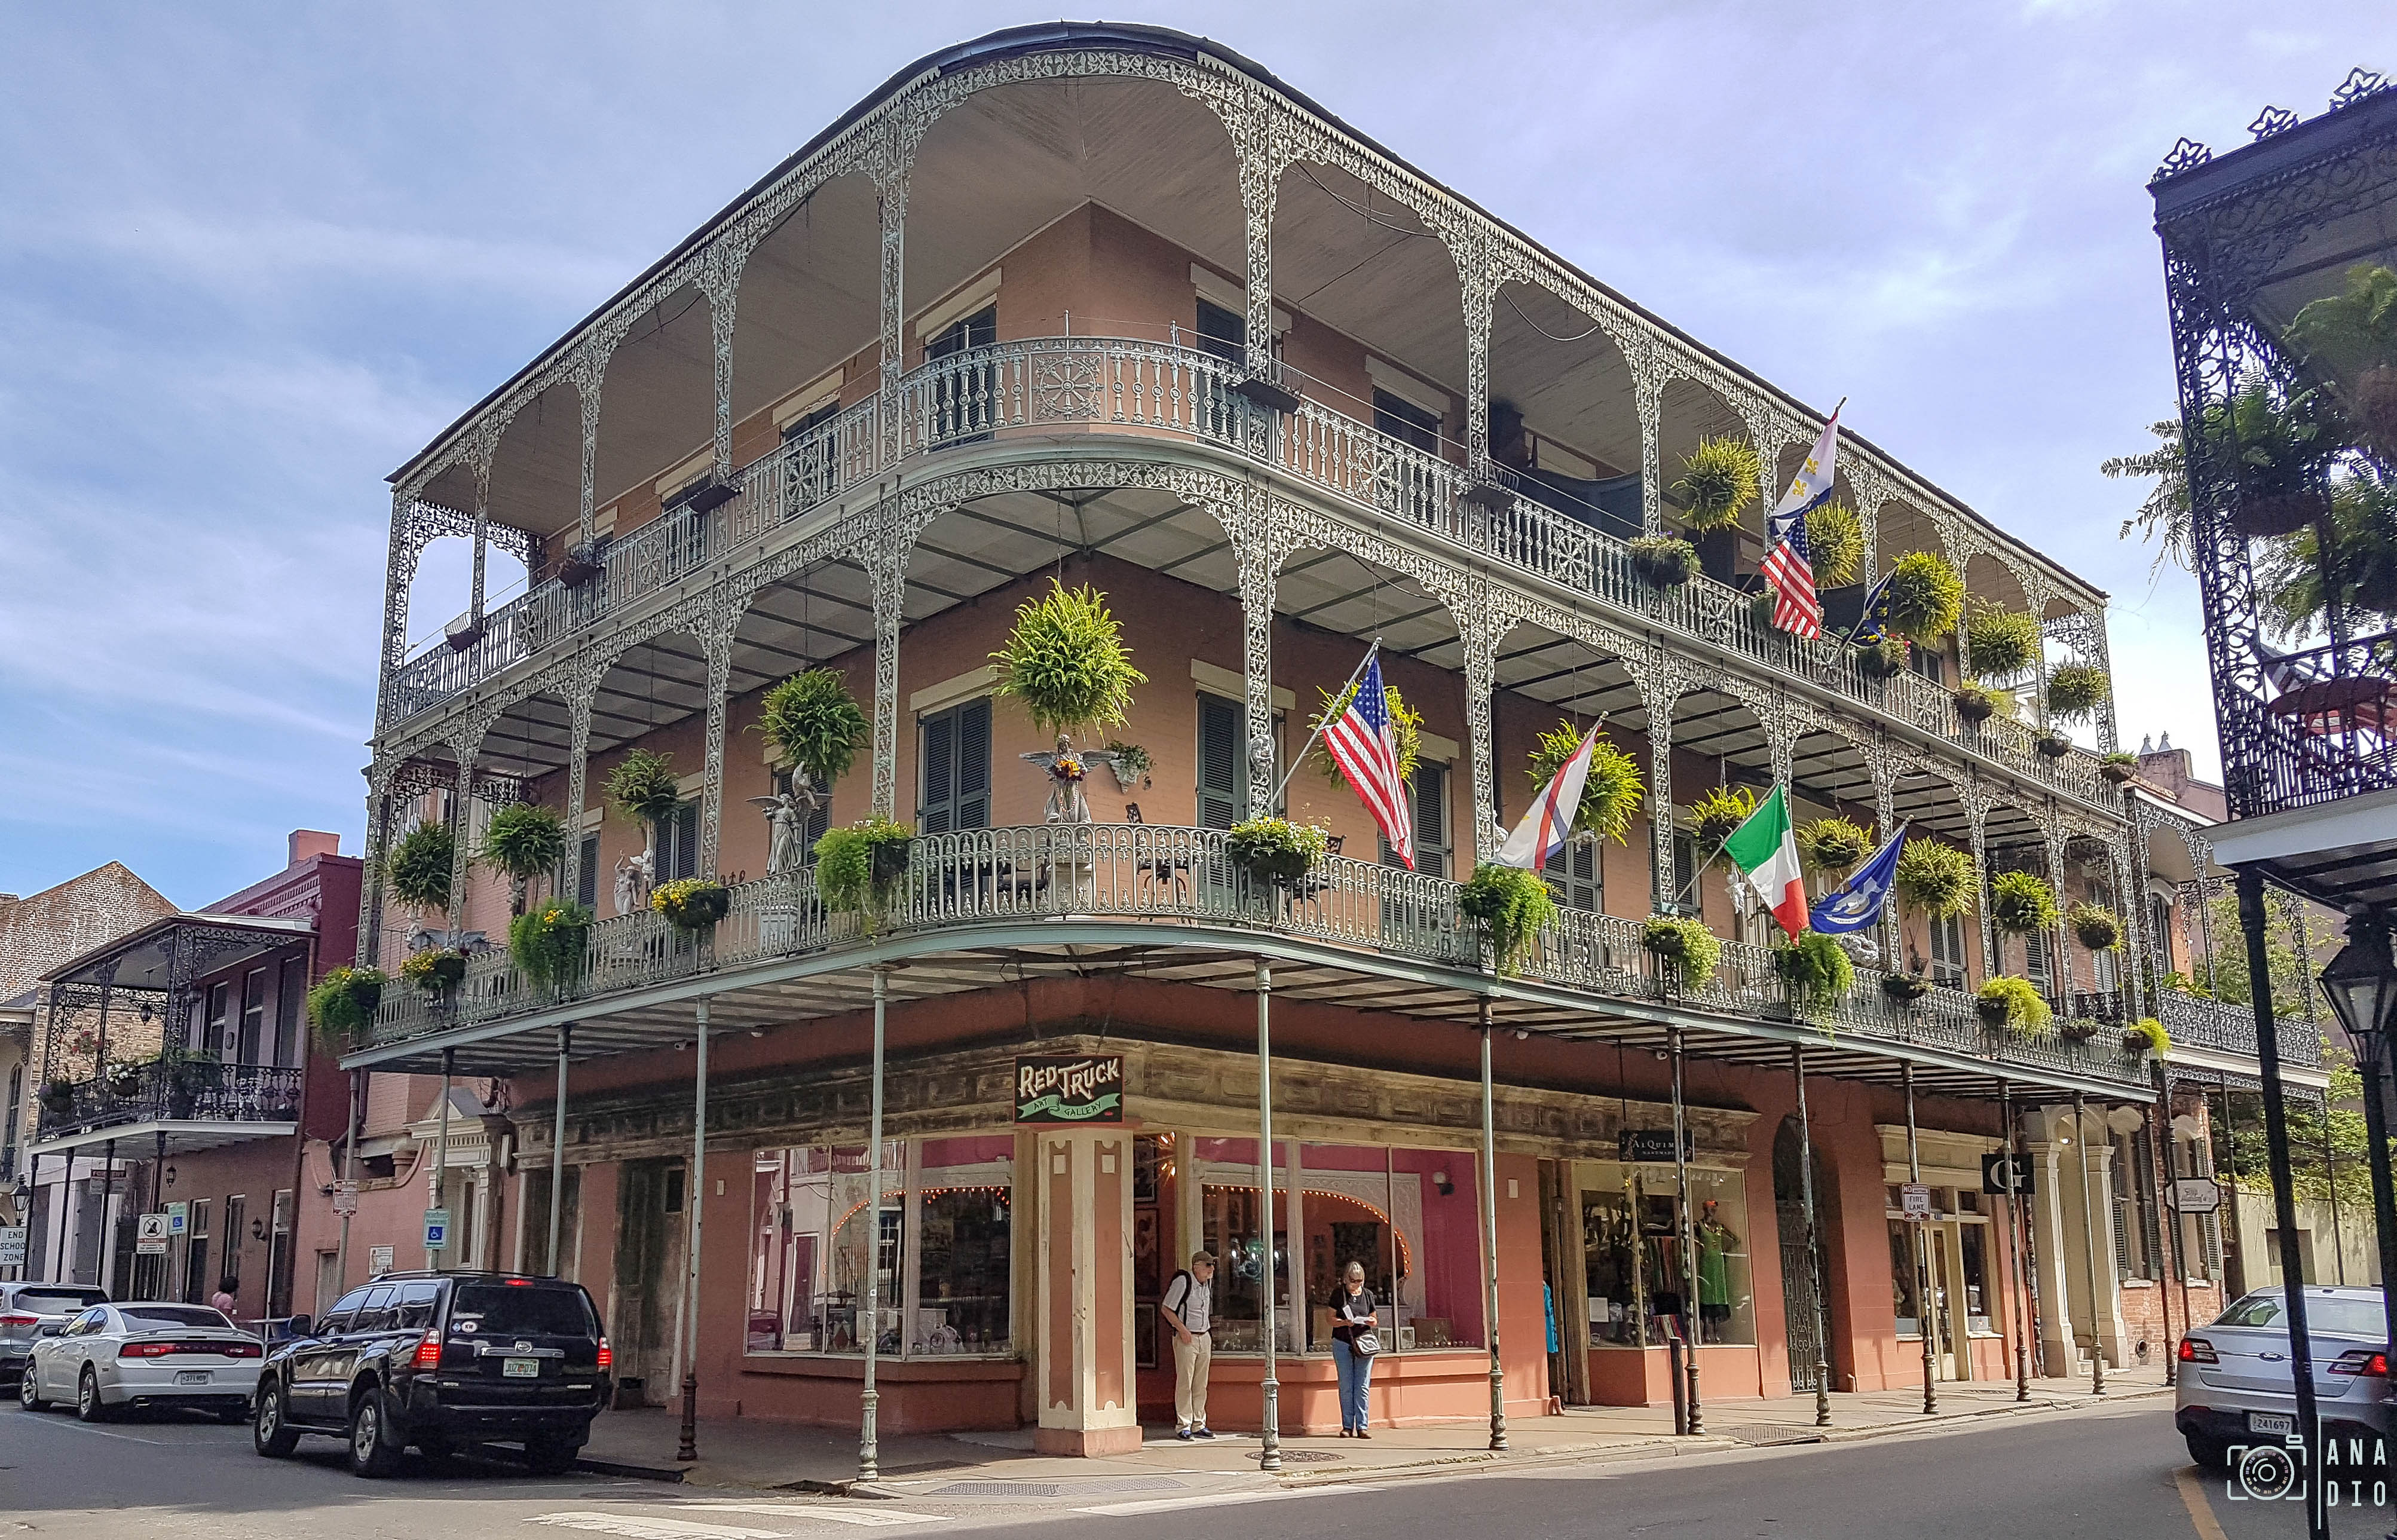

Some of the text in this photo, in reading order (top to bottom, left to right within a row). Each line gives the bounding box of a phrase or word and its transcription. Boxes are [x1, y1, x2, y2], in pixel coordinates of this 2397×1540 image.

[1018, 1057, 1121, 1100] RED TRUCK
[1034, 1098, 1048, 1110] ART
[1064, 1101, 1103, 1116] GALLERY
[1990, 1160, 2027, 1189] G
[2258, 1419, 2290, 1430] 241697
